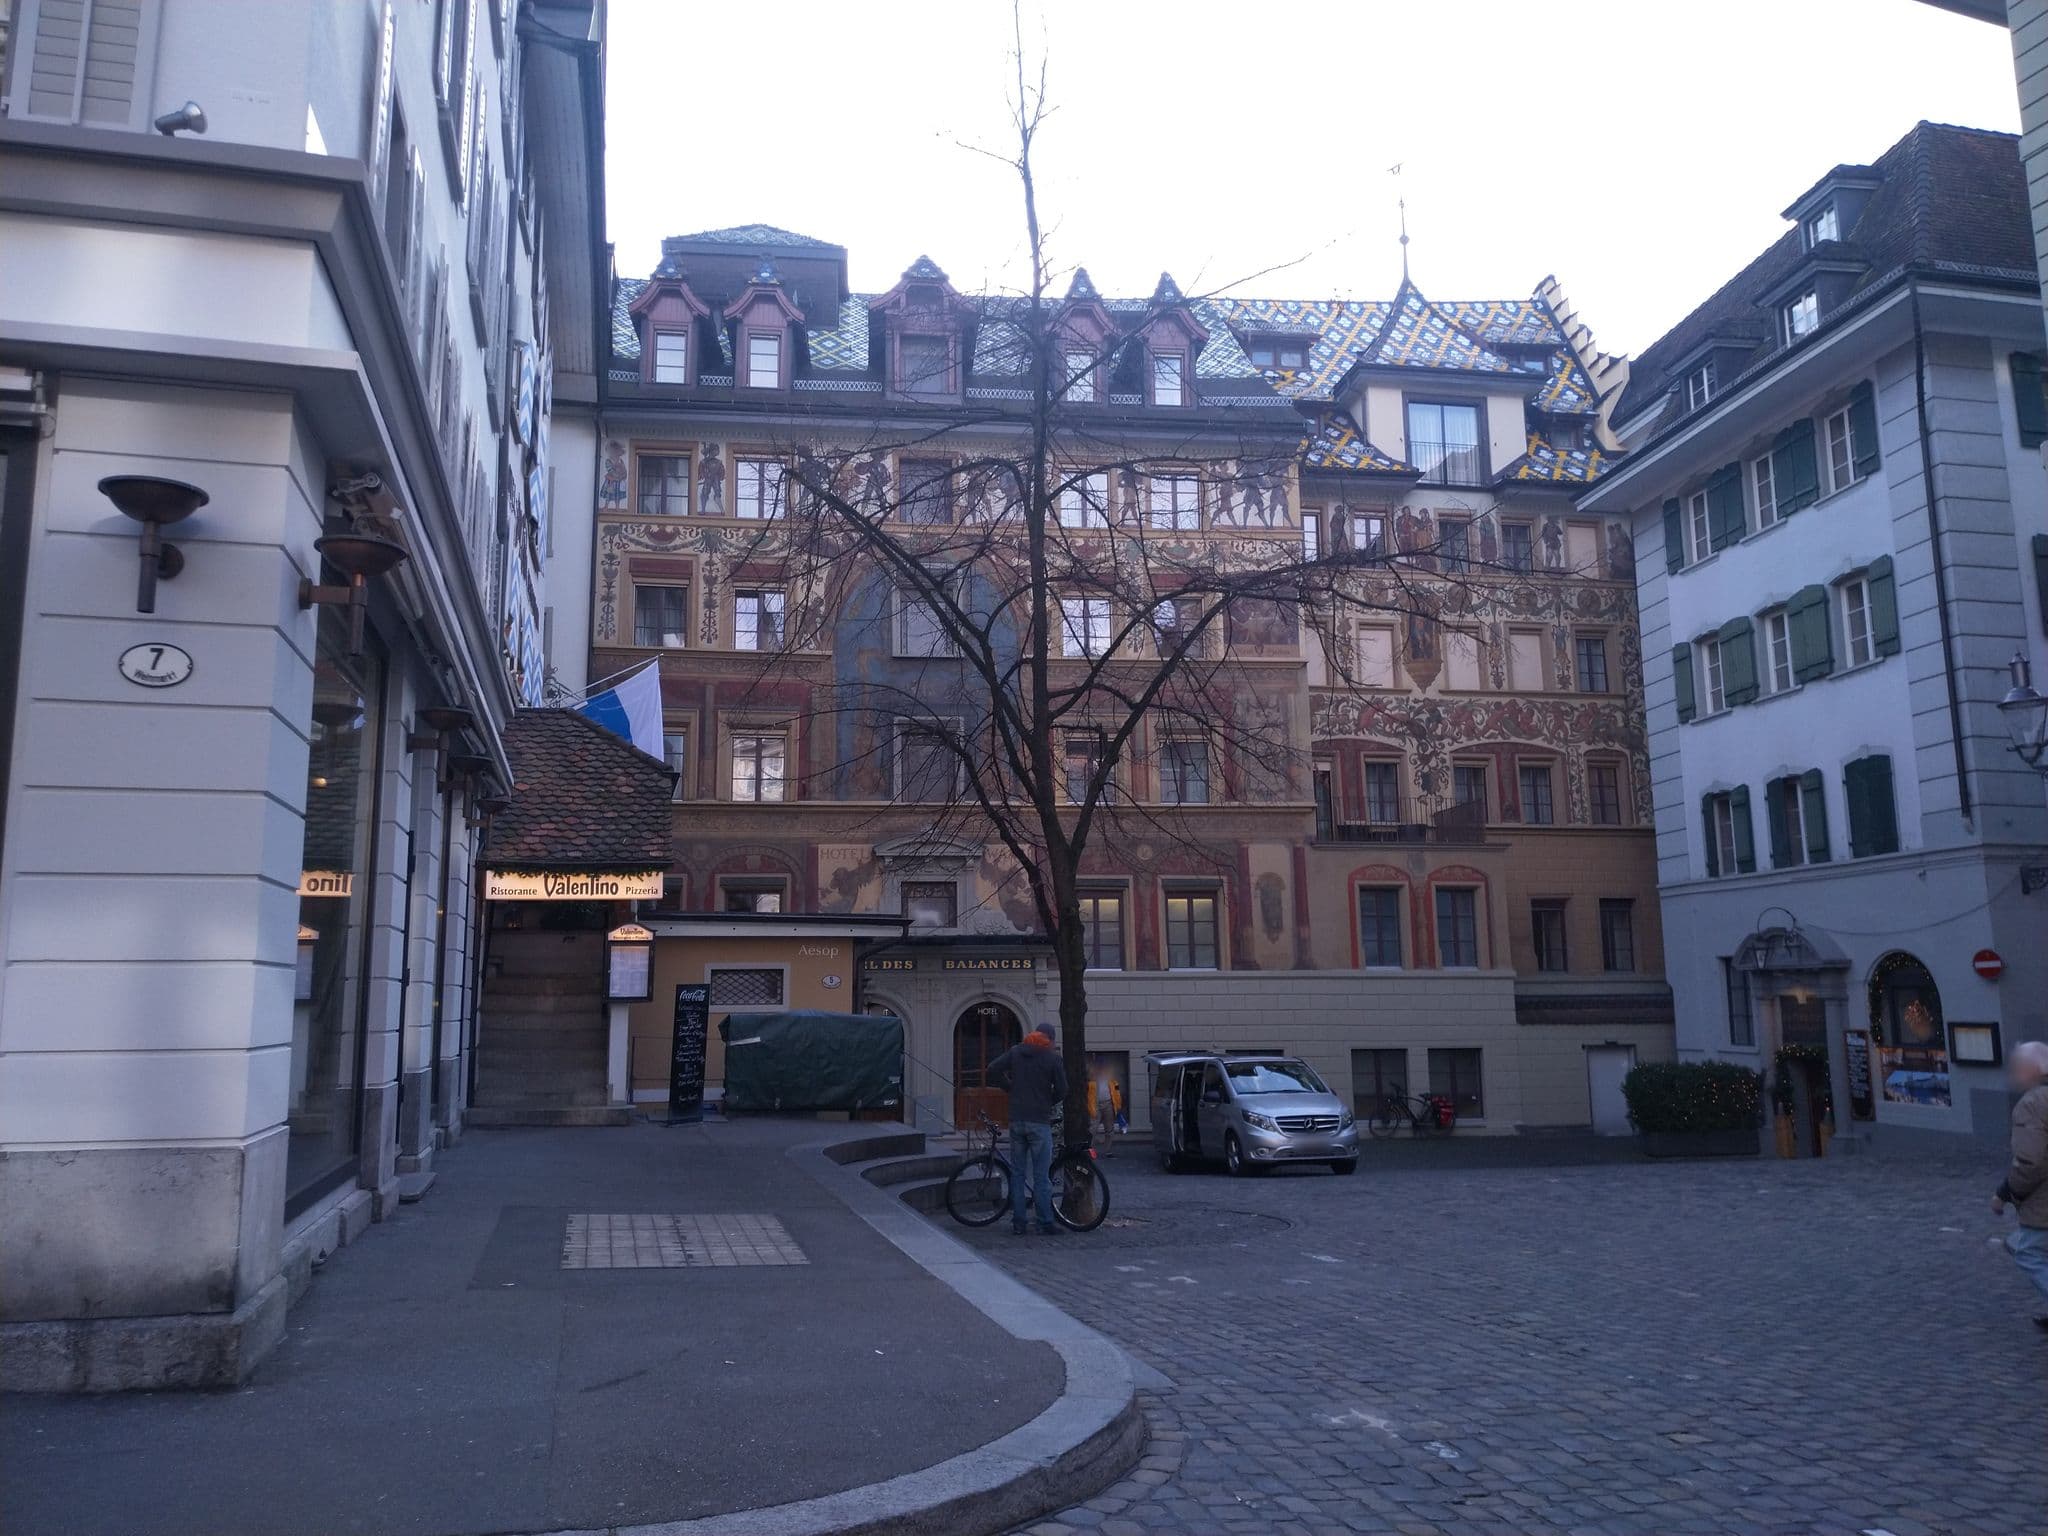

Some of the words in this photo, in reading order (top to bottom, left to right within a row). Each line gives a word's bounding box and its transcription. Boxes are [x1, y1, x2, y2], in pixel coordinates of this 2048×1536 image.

[150, 648, 164, 670] 7
[490, 886, 538, 896] Ristorante
[544, 872, 619, 897] Valentino
[625, 886, 659, 895] Pizzeria
[799, 945, 839, 959] Aesop
[882, 960, 913, 969] DES
[945, 960, 1032, 969] BALANCES
[977, 1007, 998, 1015] HOTEL
